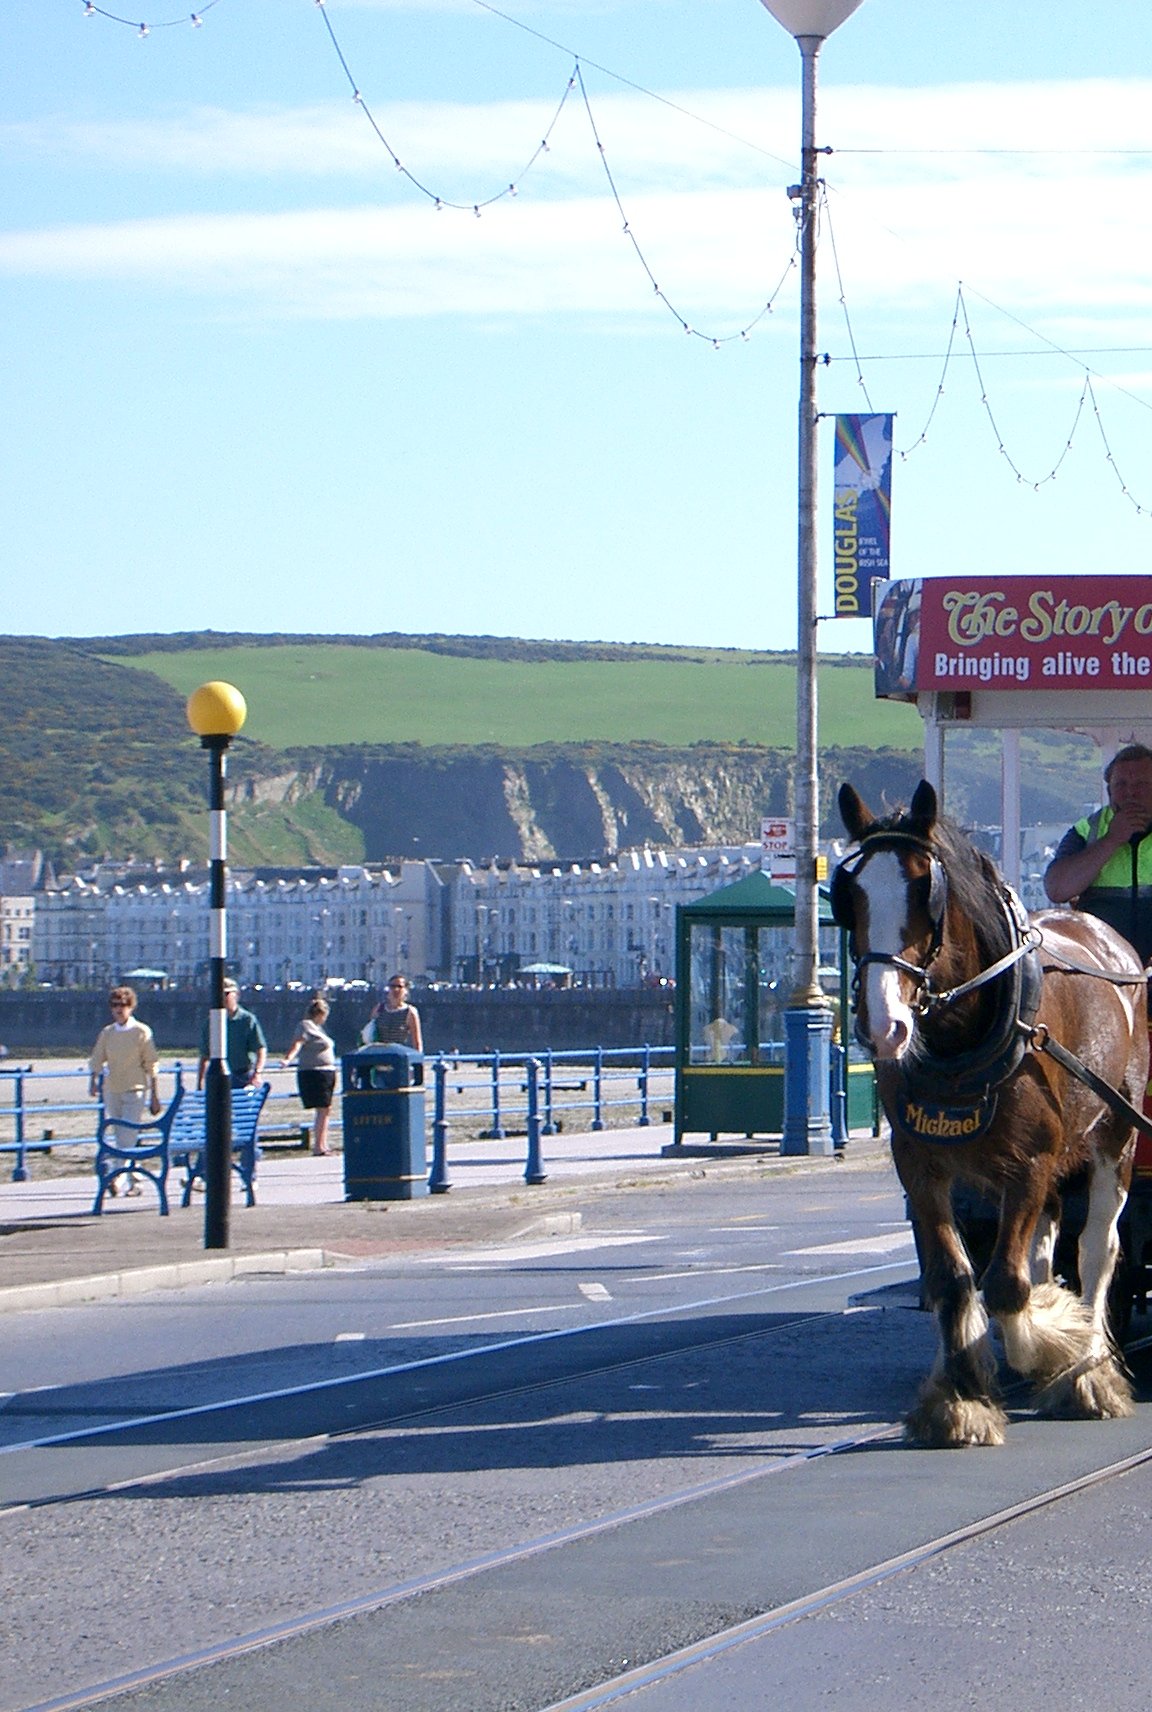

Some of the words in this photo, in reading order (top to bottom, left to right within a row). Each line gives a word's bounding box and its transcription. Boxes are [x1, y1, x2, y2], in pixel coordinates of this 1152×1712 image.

[835, 489, 859, 612] DOUGLAS
[943, 591, 1018, 646] The
[1020, 591, 1133, 645] Story
[935, 652, 1029, 681] Bringing
[1042, 652, 1100, 676] alive
[1111, 652, 1150, 676] the
[762, 841, 788, 850] STOP
[905, 1103, 981, 1136] Michael
